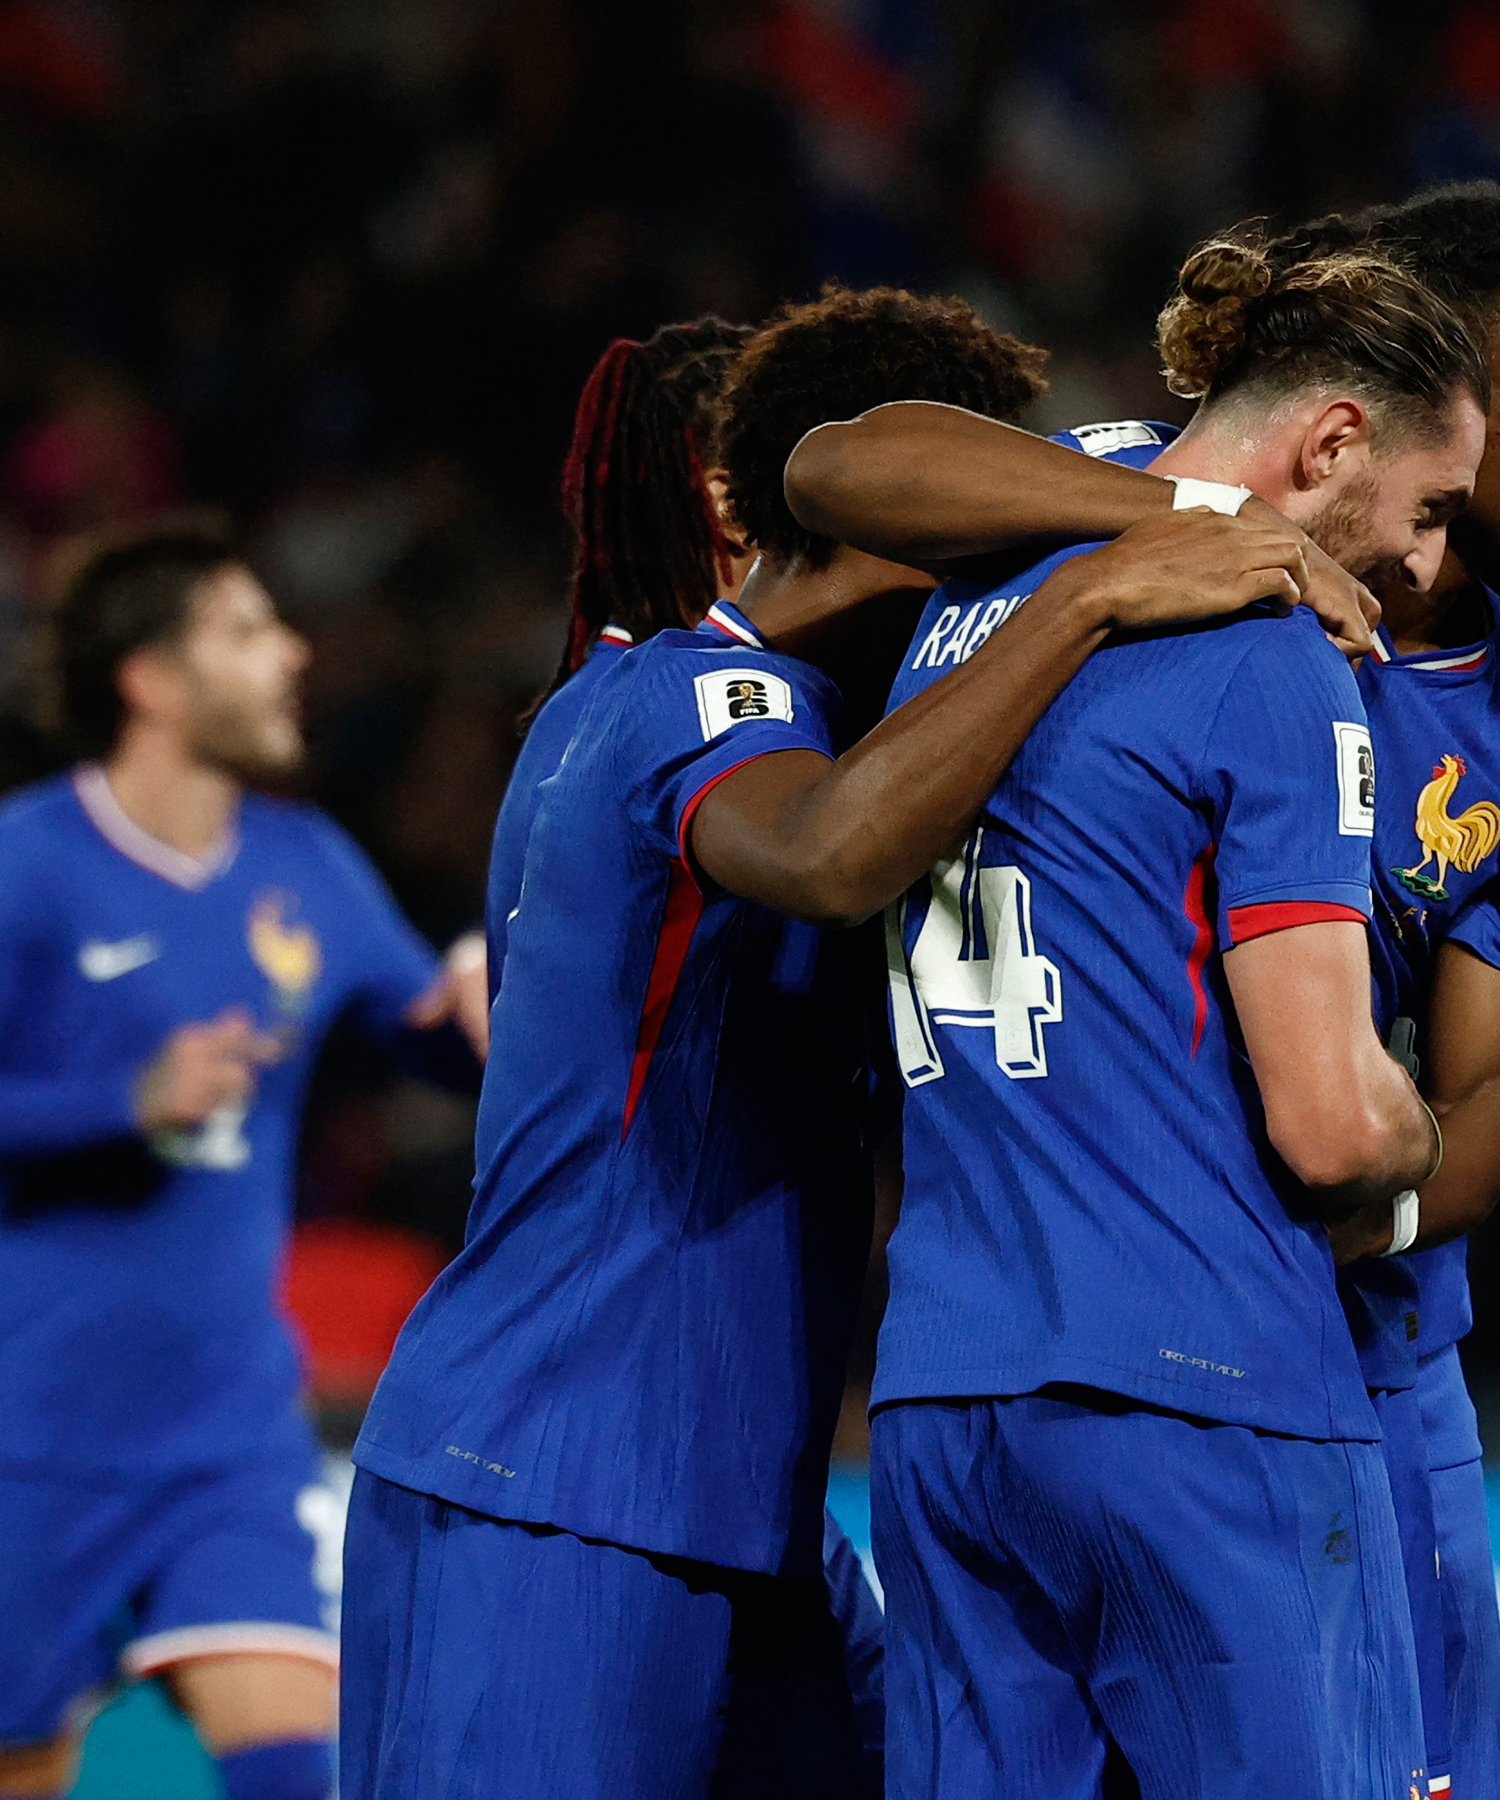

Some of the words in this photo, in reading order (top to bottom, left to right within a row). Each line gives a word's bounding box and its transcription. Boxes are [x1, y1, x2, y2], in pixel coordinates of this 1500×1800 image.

[911, 594, 1032, 670] RABI
[739, 707, 760, 715] FIFA
[884, 826, 1063, 1089] 14
